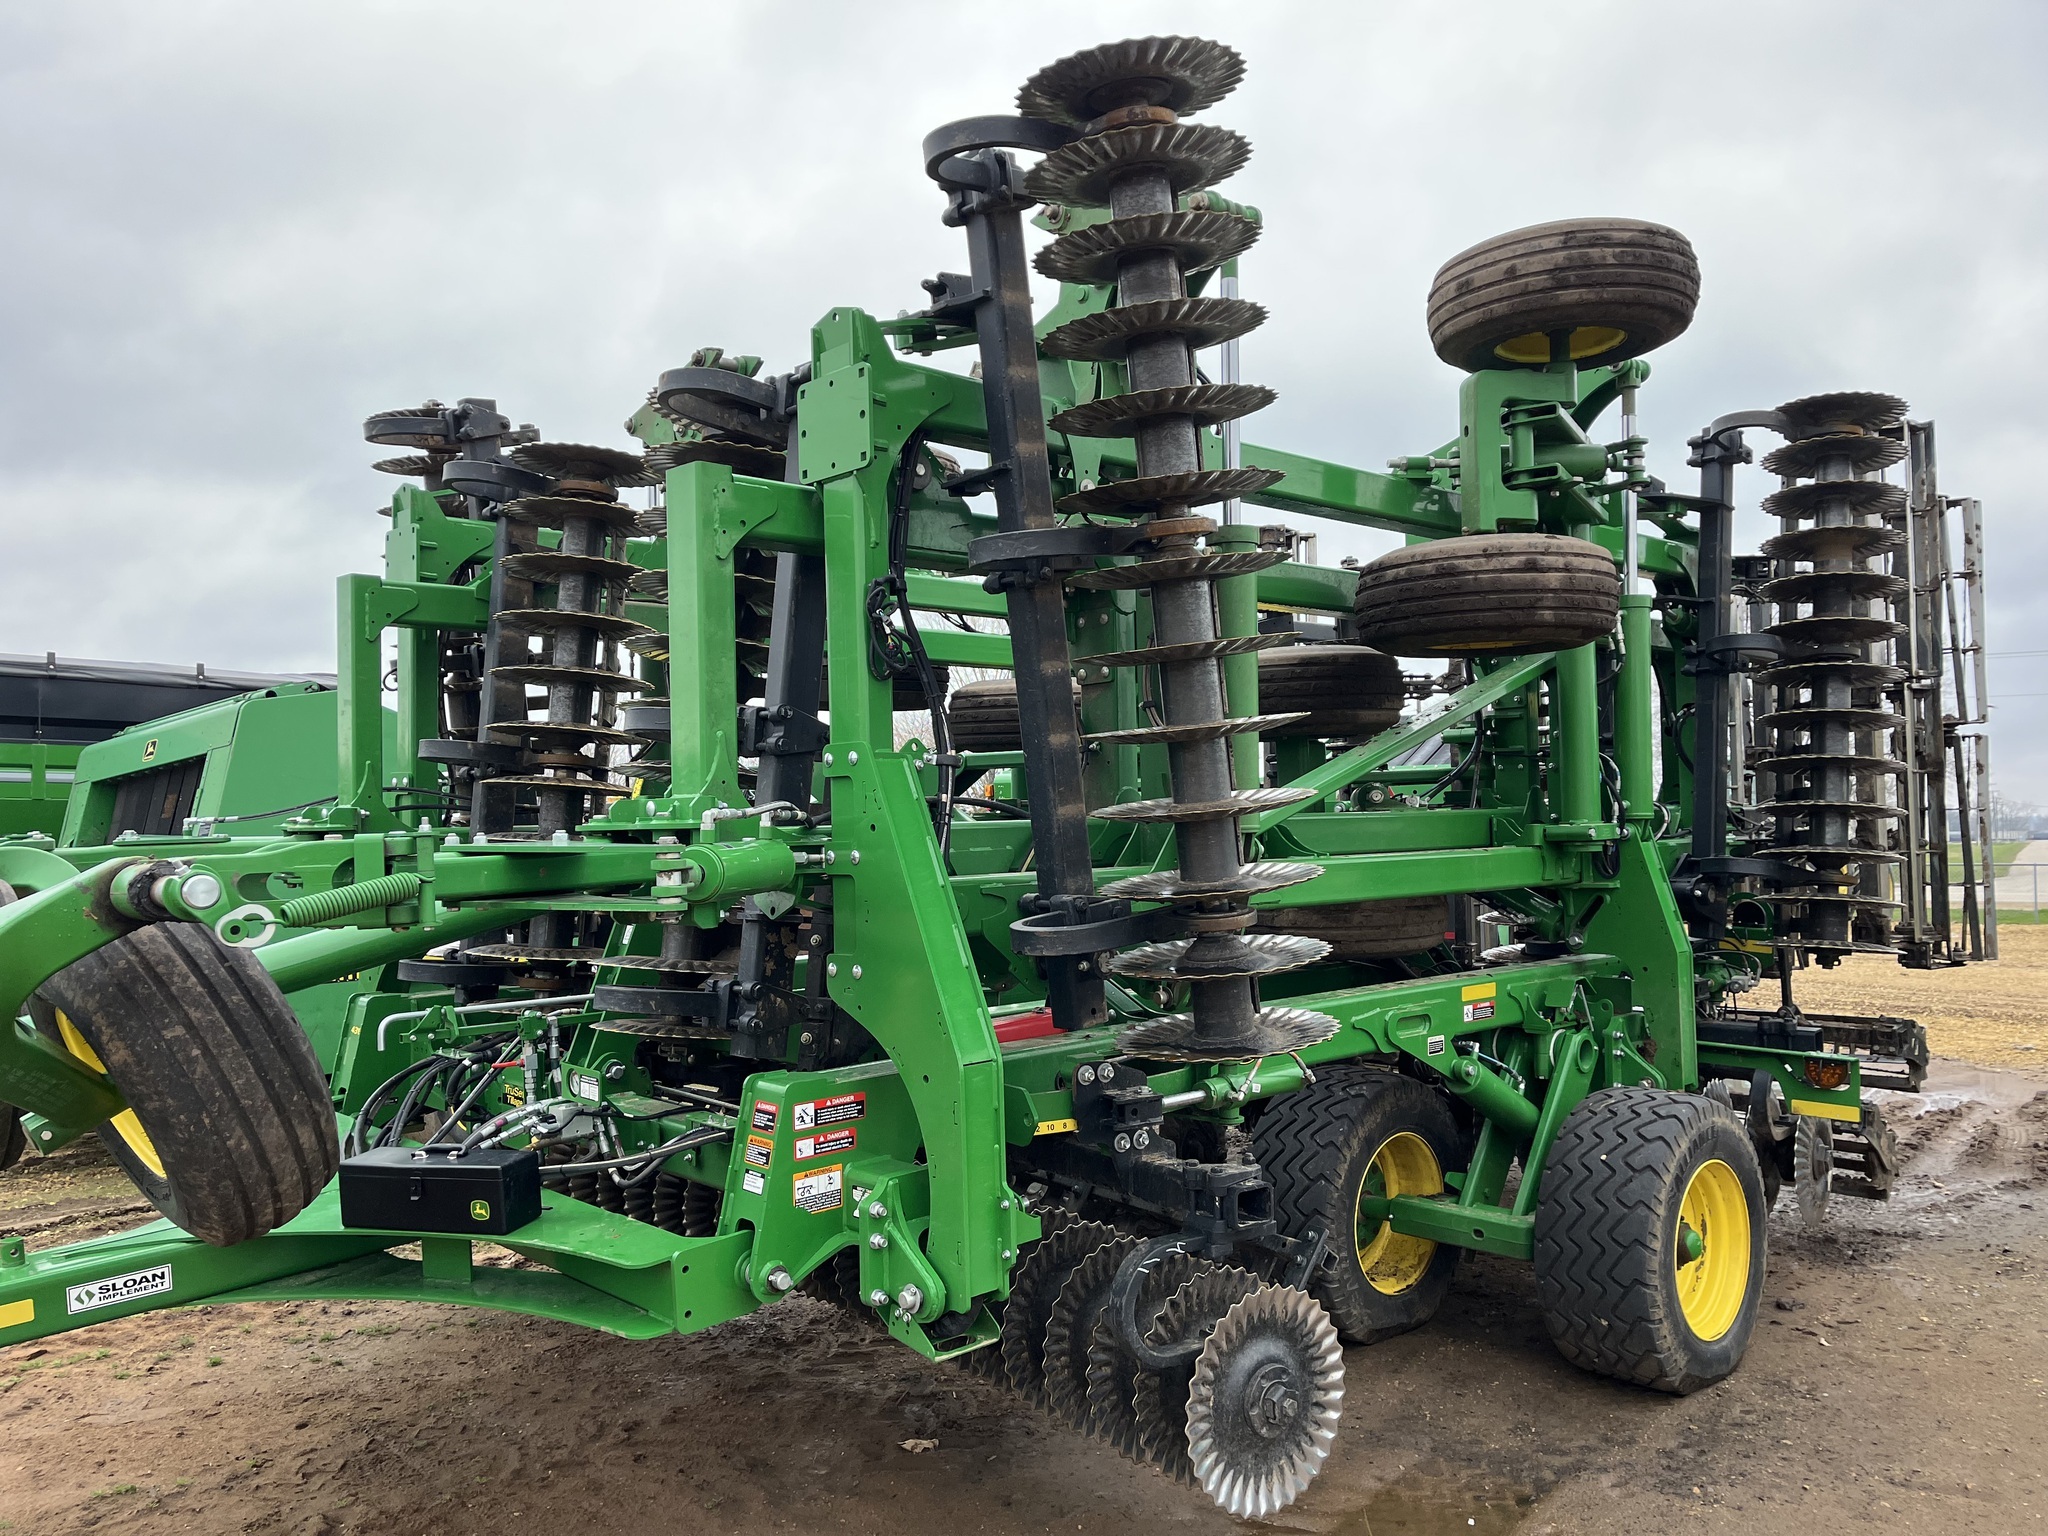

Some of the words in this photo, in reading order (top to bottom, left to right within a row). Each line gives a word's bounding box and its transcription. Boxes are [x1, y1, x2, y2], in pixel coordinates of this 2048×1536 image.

[832, 1095, 855, 1105] DANGER
[760, 1103, 777, 1111] DANGER
[1046, 1123, 1055, 1131] 10
[827, 1130, 850, 1140] DANGER
[753, 1138, 772, 1148] WARNING
[808, 1167, 833, 1176] WARNING
[98, 1271, 165, 1294] SLOAN
[98, 1281, 165, 1302] IMPLEMENT
